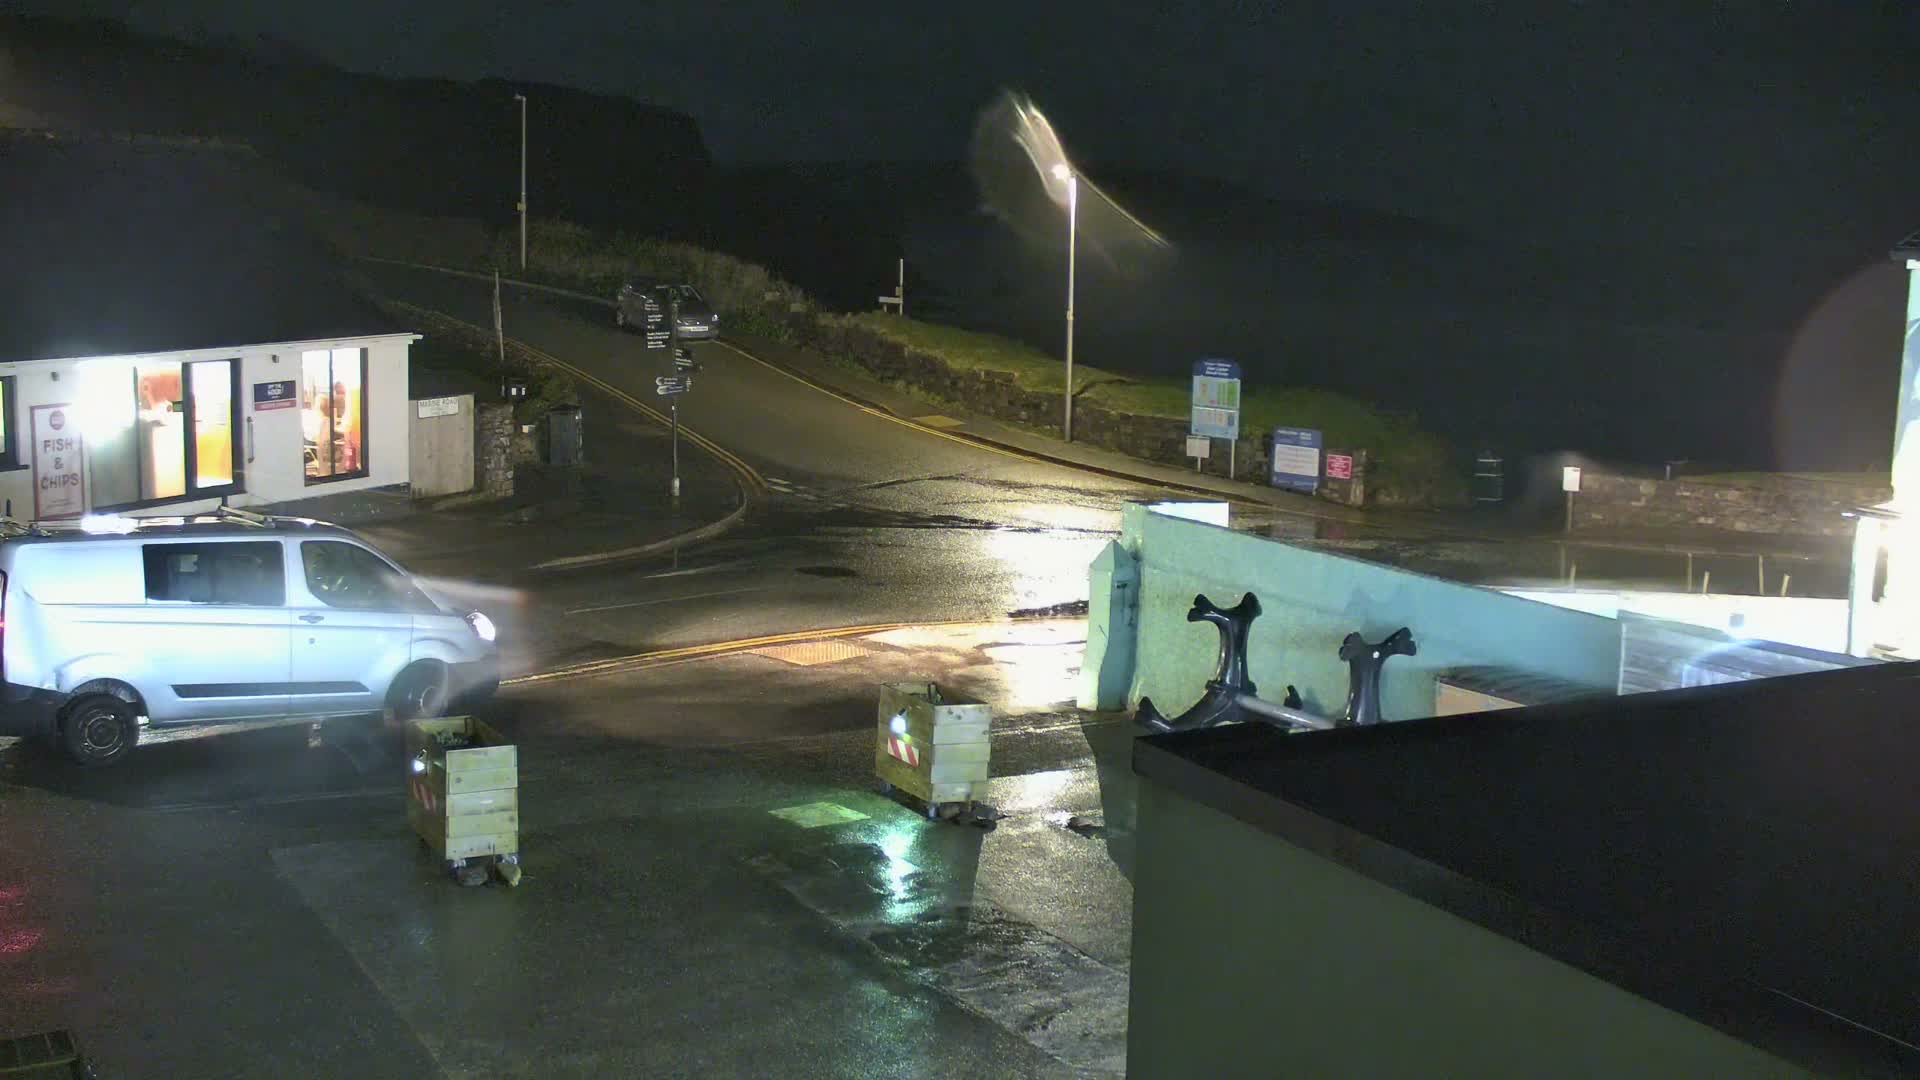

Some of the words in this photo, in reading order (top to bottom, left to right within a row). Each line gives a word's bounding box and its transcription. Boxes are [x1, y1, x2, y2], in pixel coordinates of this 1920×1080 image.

[43, 438, 73, 454] FISH
[54, 457, 64, 469] &
[41, 473, 79, 489] CHIPS
